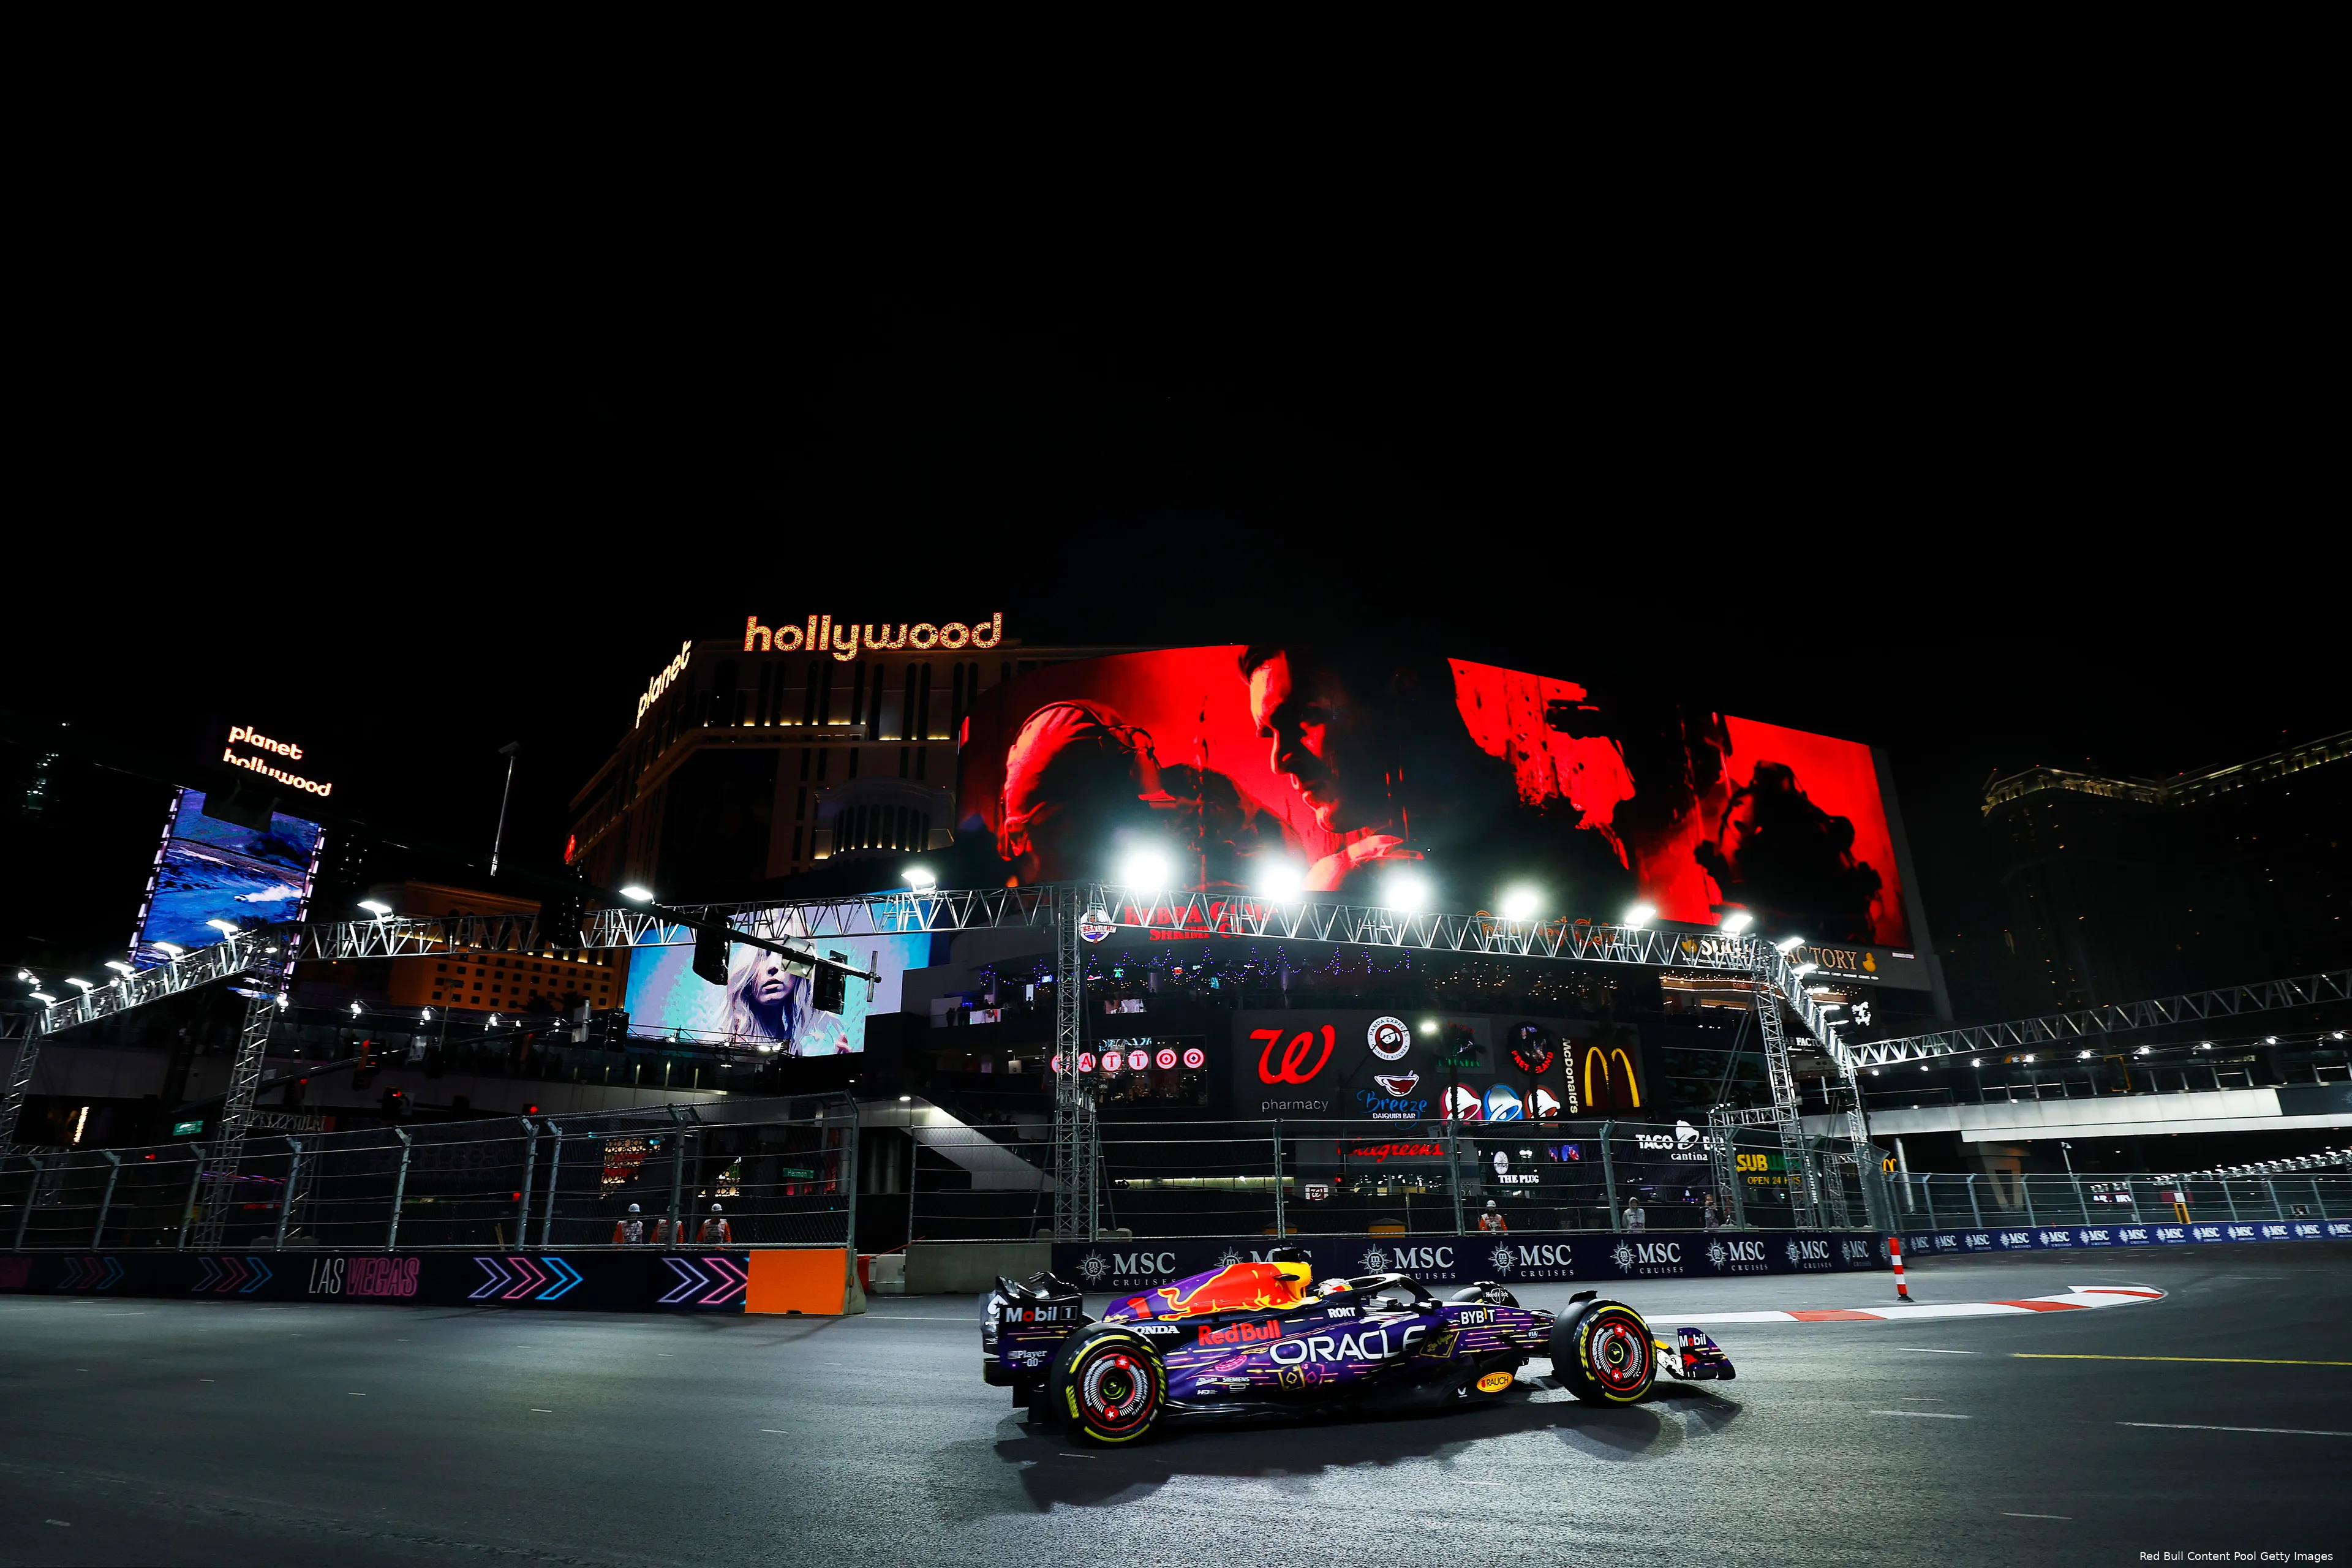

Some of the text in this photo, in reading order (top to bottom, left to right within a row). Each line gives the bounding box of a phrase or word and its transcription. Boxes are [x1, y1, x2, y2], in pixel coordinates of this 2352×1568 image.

[743, 612, 1002, 662] hollywood
[635, 640, 692, 729] planet
[228, 726, 304, 760] planet
[1786, 945, 1857, 970] ACTORY
[1369, 1017, 1409, 1038] PANDA EXPRES
[1562, 1038, 1578, 1114] McDonald's
[1262, 1098, 1329, 1112] pharmacy
[1357, 1089, 1428, 1126] Breeze
[1635, 1134, 1674, 1150] TACO
[1671, 1152, 1708, 1161] cantina
[1498, 1175, 1539, 1183] THE PLUG
[1747, 1176, 1770, 1185] OPEN
[1393, 1246, 1455, 1269] MSC
[1518, 1245, 1572, 1267] MSC
[1636, 1243, 1681, 1264] MSC
[1727, 1242, 1766, 1261] MSC
[1800, 1241, 1830, 1259] MSC
[1849, 1240, 1869, 1258] MSC
[1112, 1252, 1176, 1275] MSC
[308, 1257, 420, 1296] LAS VEGAS
[1005, 1306, 1072, 1322] Mobil 1
[1127, 1297, 1152, 1318] 1
[1327, 1307, 1356, 1318] ROKT
[1460, 1307, 1495, 1325] BYBIT
[1133, 1325, 1180, 1335] ONDA
[1197, 1319, 1281, 1346] Red Bull
[1269, 1325, 1427, 1365] ORACLE
[1679, 1333, 1707, 1348] Mobil
[1017, 1350, 1047, 1359] Player
[1486, 1376, 1509, 1387] RAUCH
